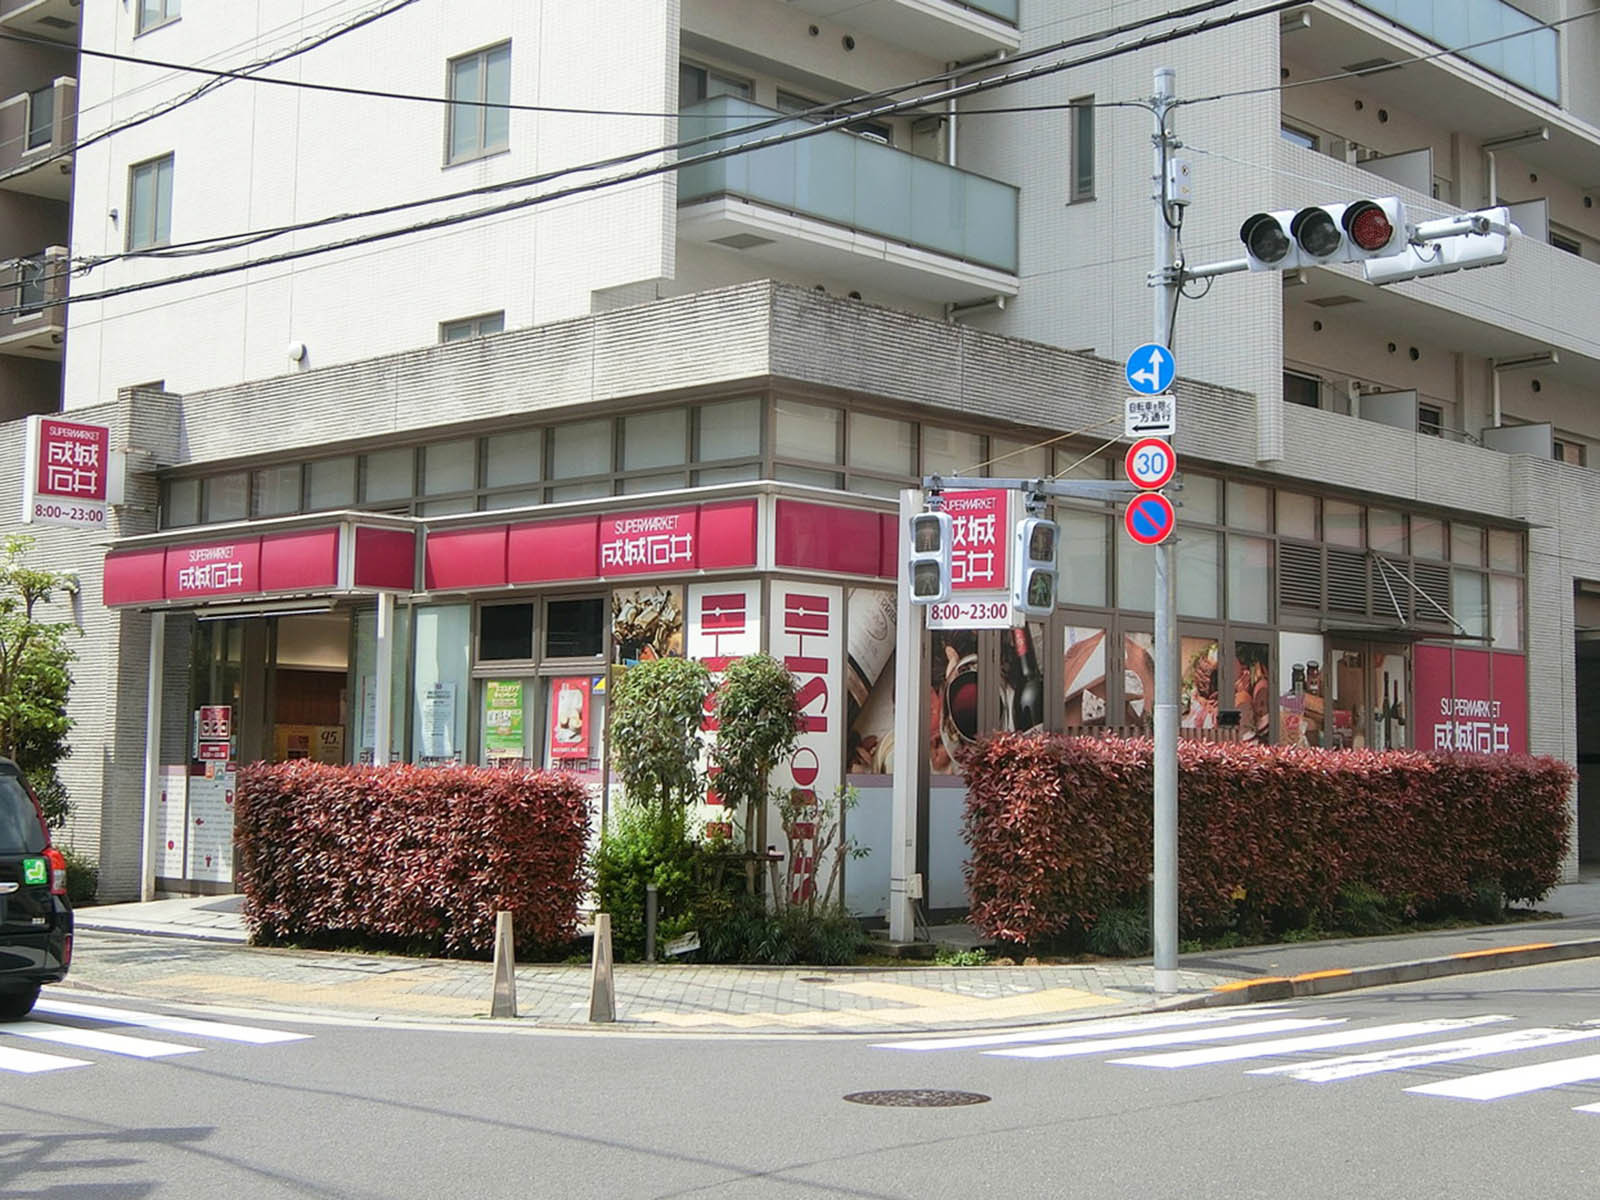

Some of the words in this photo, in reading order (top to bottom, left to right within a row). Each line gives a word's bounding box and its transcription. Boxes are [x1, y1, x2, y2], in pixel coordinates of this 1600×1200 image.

[1129, 412, 1171, 423] 一方通行
[48, 426, 100, 440] SUPERMARKET
[48, 441, 99, 468] 成城
[1137, 453, 1164, 475] 30
[48, 465, 98, 494] 石井
[940, 497, 997, 511] SUPERMARKET
[614, 514, 680, 535] SUPERMARKET
[188, 546, 236, 562] SUPERMARKET
[602, 532, 692, 568] 成城石井
[179, 561, 243, 591] 成城石井
[1440, 698, 1501, 718] SUPERMARKET
[1434, 720, 1510, 754] 成城石井
